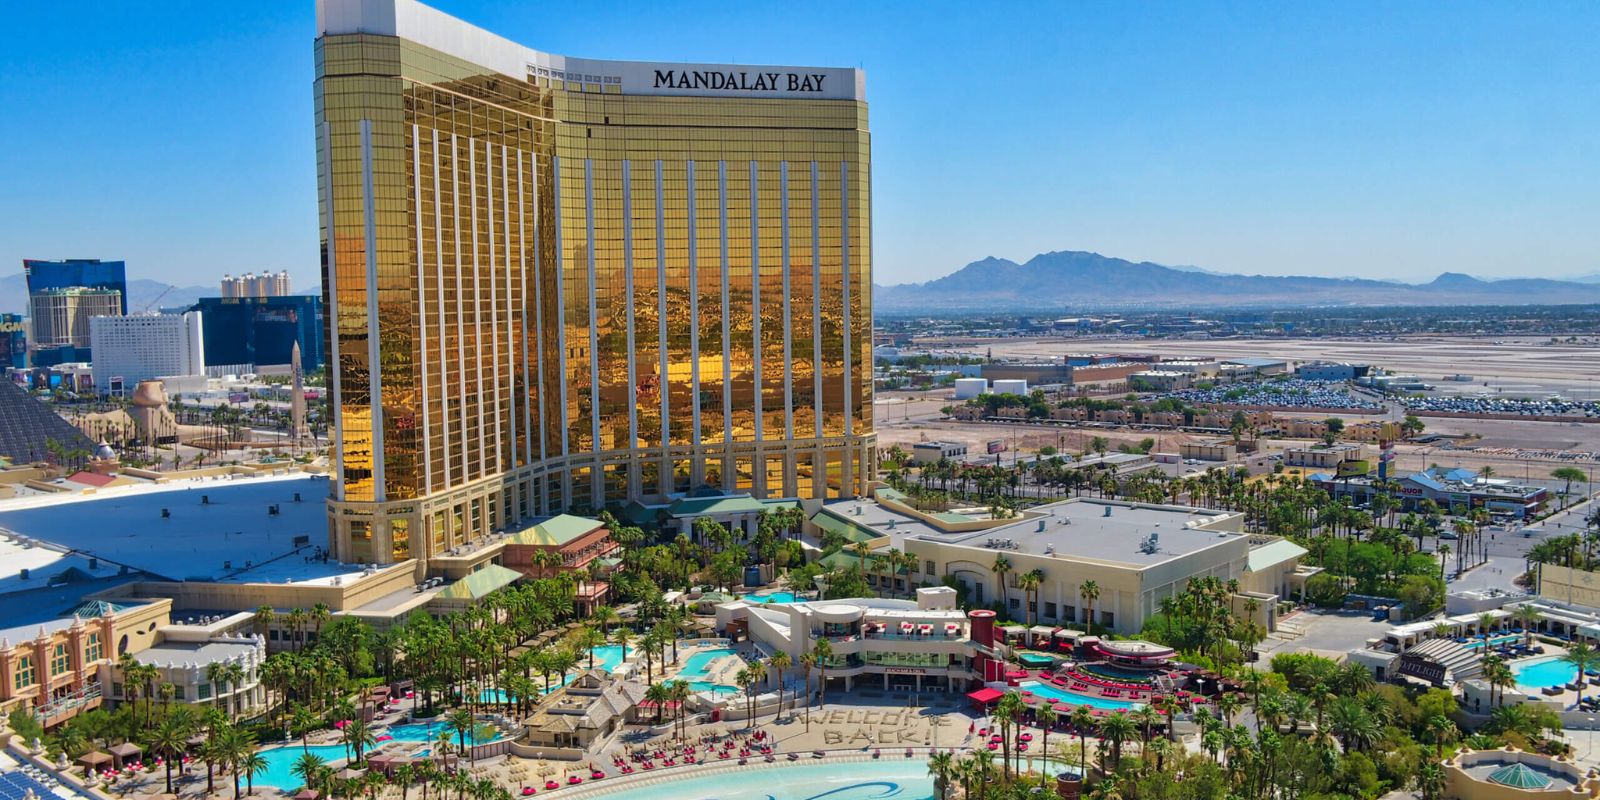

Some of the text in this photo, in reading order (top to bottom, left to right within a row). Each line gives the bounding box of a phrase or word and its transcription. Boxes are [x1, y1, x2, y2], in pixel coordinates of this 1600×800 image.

[653, 70, 826, 92] MANDALAY BAY
[823, 728, 932, 746] BACK!
